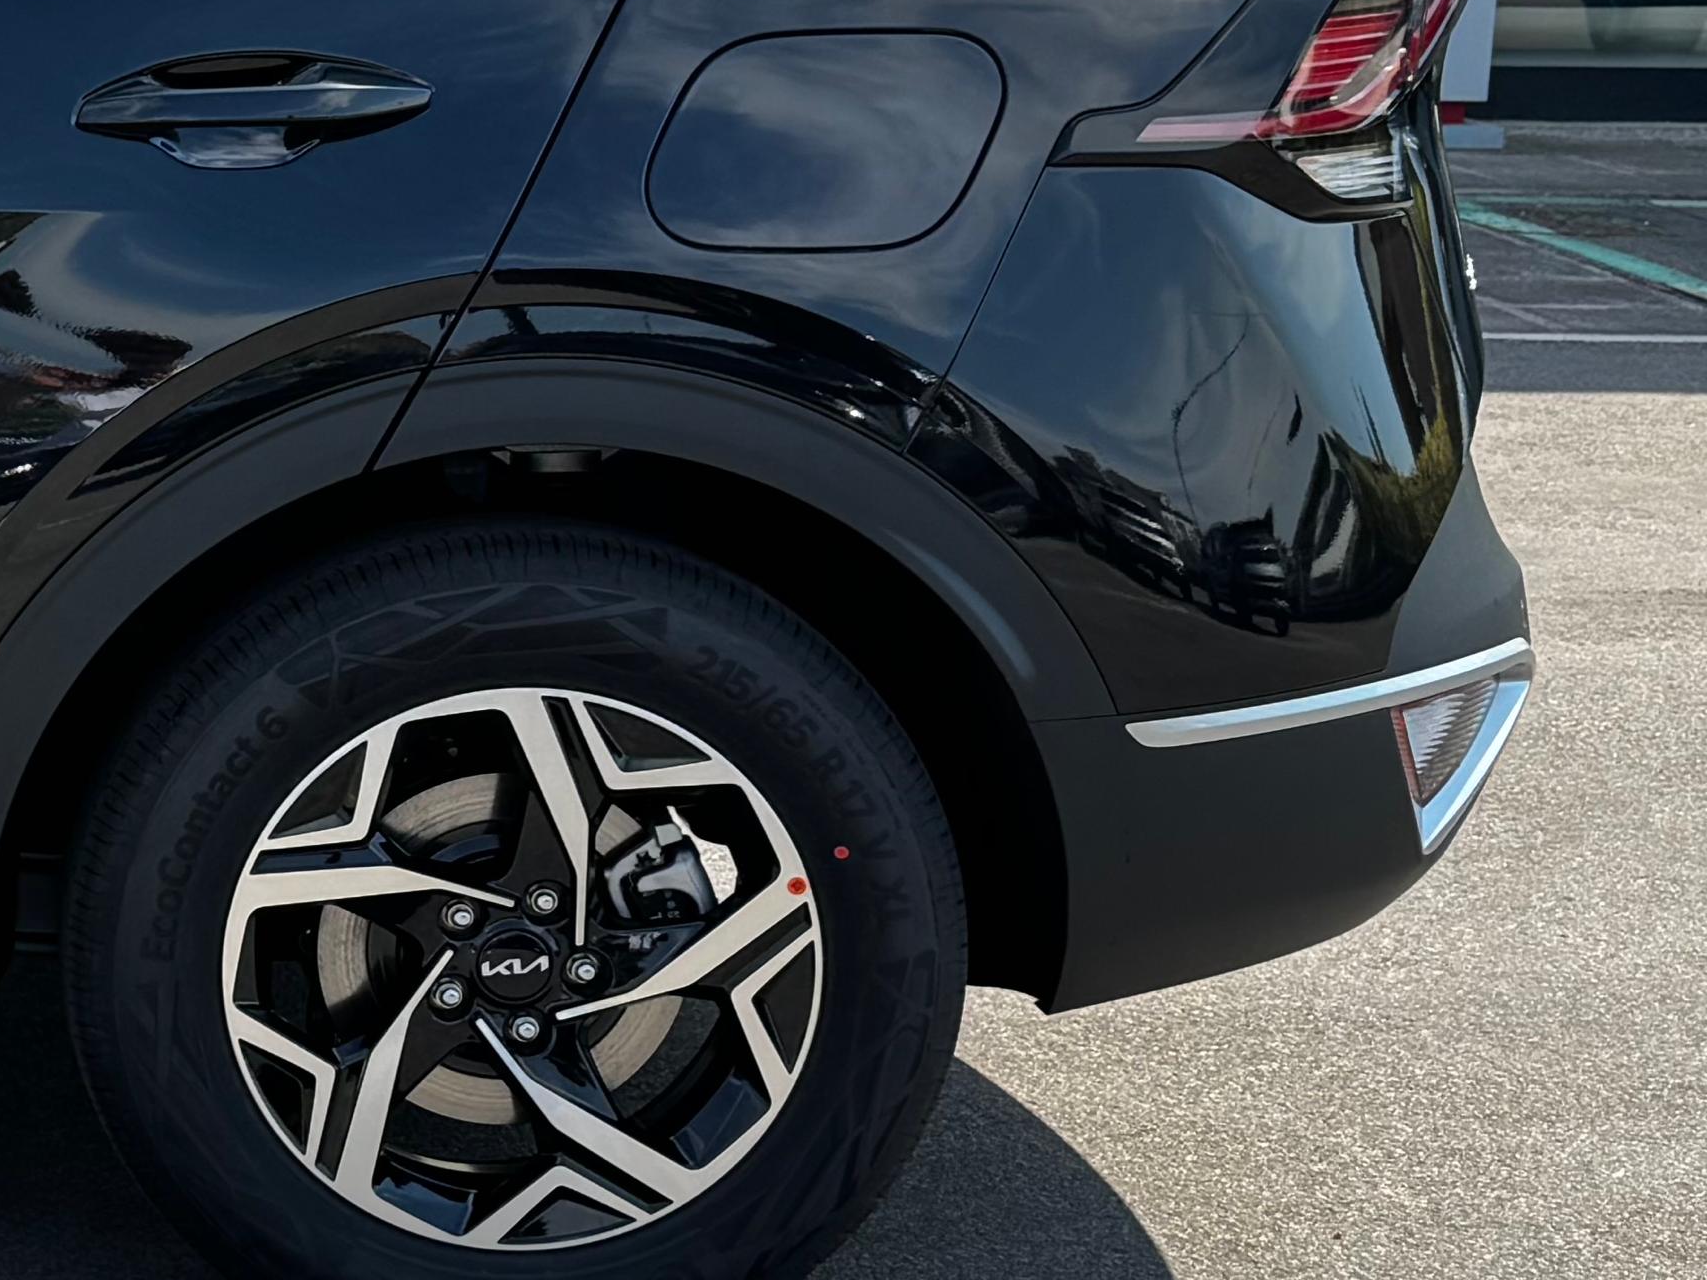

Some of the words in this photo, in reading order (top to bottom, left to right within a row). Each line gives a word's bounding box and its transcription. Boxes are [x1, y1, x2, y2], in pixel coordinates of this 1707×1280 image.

[688, 642, 821, 754] 215/65
[141, 732, 266, 961] EcoContact
[249, 703, 291, 745] 6
[481, 955, 549, 977] KIA
